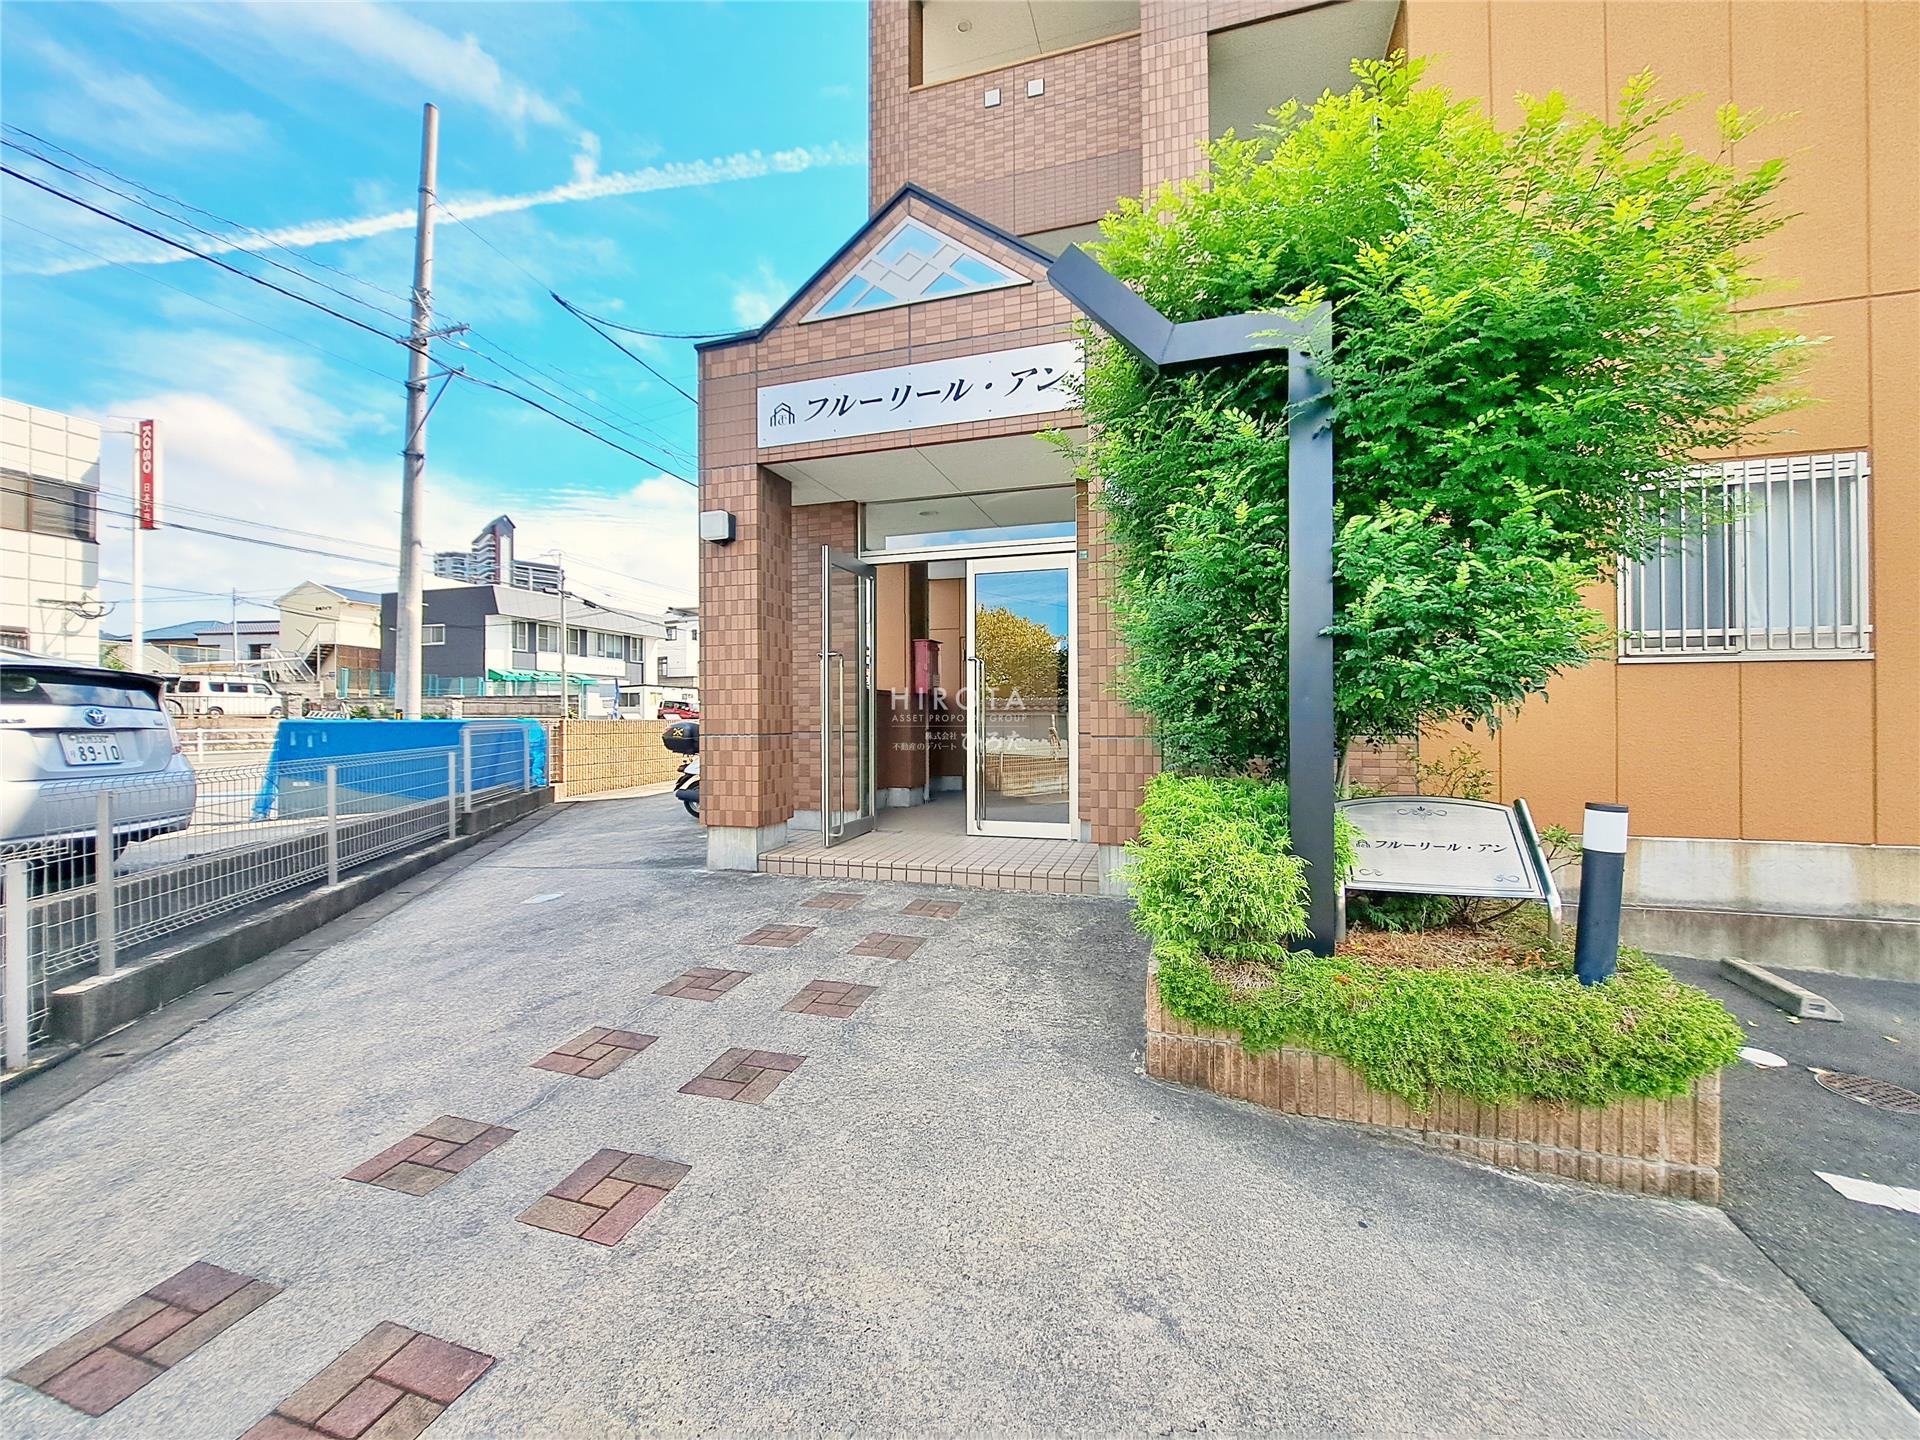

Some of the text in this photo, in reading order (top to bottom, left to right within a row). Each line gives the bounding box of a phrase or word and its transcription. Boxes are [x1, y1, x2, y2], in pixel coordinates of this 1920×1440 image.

[804, 366, 1069, 422] フルーリール・アン
[142, 425, 152, 474] KOSO
[78, 745, 120, 762] 89-10
[1374, 839, 1508, 854] フルーリール・アン
